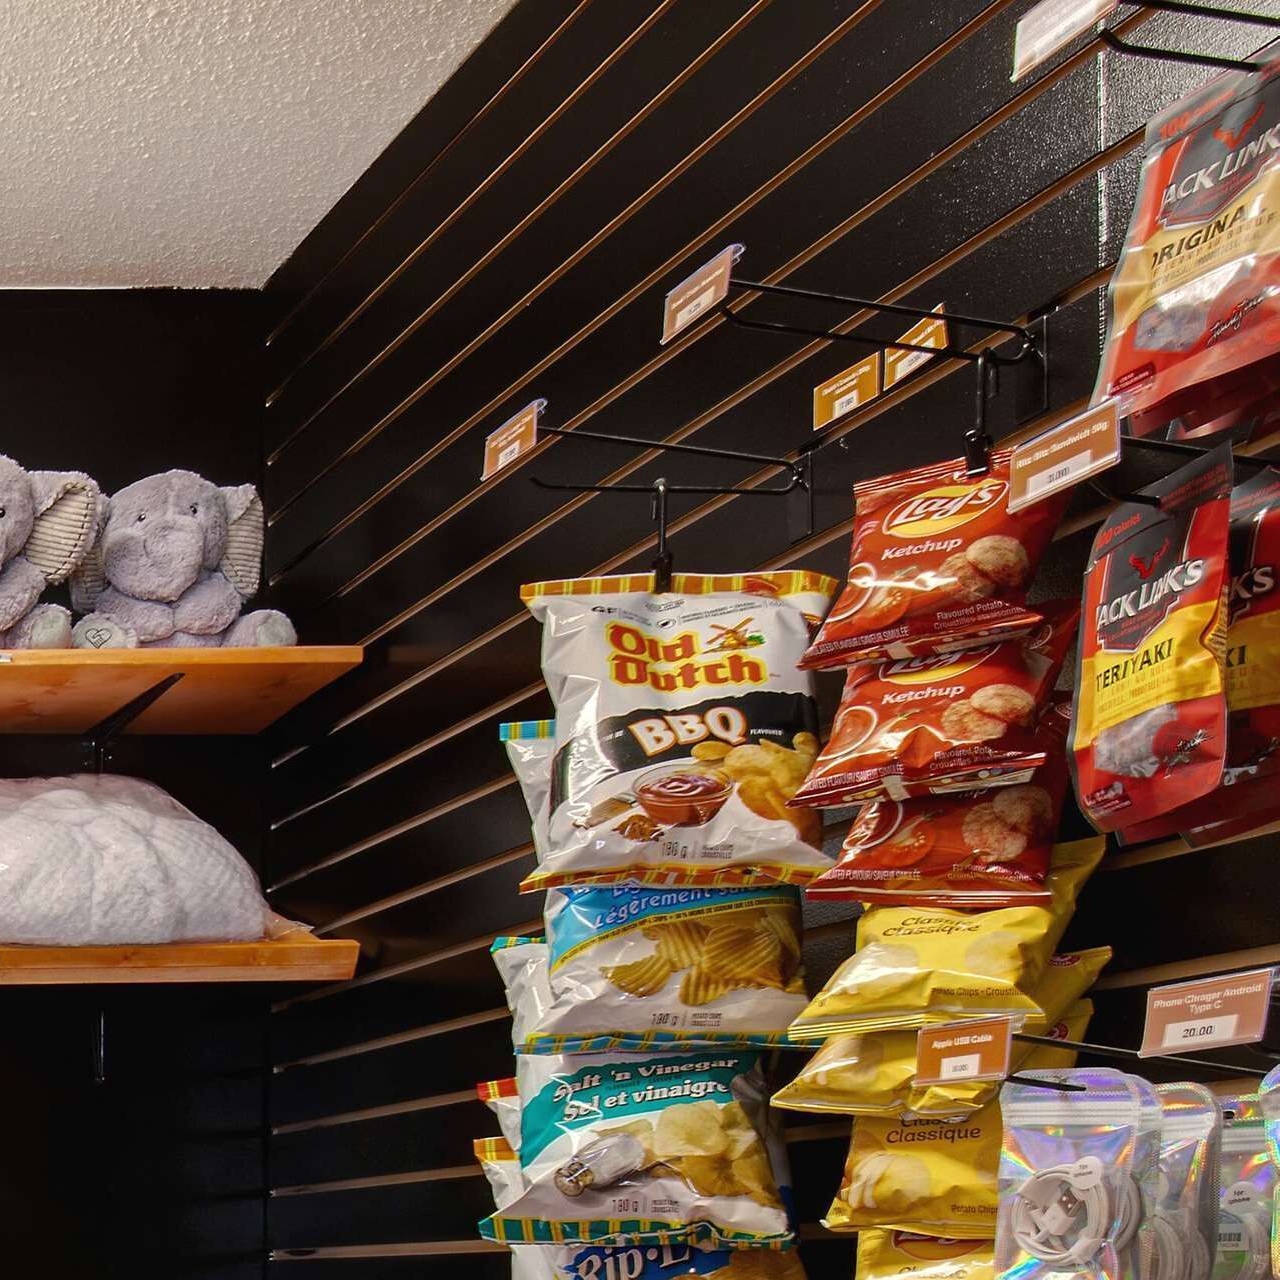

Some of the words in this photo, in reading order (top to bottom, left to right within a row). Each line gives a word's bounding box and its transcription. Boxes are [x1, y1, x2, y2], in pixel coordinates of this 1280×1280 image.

[890, 483, 1002, 527] Lay's
[881, 537, 964, 561] Ketchup
[1138, 558, 1205, 612] LINK'S
[609, 623, 697, 660] Old
[611, 654, 764, 693] Dutch
[881, 684, 966, 705] Ketchup
[627, 705, 747, 757] BBQ
[593, 888, 711, 930] Légèrement
[882, 924, 981, 937] Classique
[1153, 997, 1183, 1009] Phone
[1222, 983, 1263, 997] Android
[1189, 1002, 1212, 1015] Type
[1182, 1025, 1216, 1039] 20.00
[552, 1069, 602, 1104] Salt
[637, 1057, 739, 1077] Vinegar
[563, 1096, 600, 1123] Sel
[604, 1093, 631, 1107] et
[885, 1124, 982, 1145] Classique
